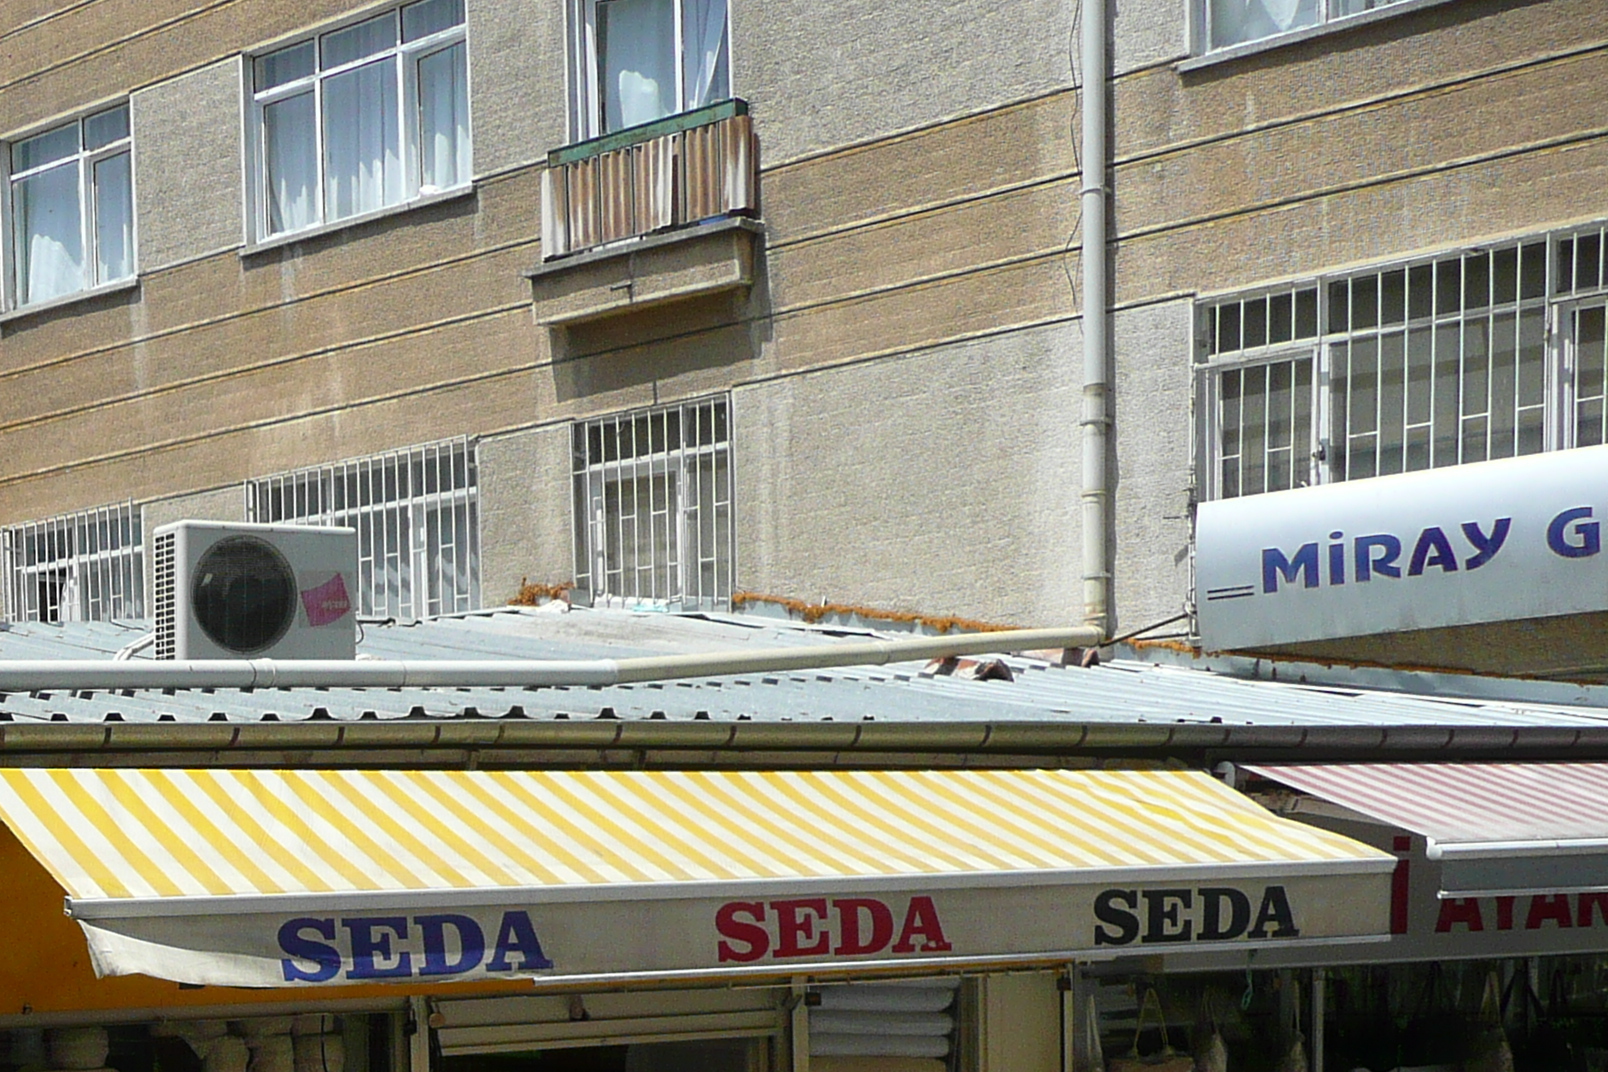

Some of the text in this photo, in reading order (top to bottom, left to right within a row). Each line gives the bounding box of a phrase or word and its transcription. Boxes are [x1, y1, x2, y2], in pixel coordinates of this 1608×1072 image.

[277, 910, 554, 982] SEDA
[715, 896, 953, 962] SEDA
[1094, 886, 1300, 945] SEDA
